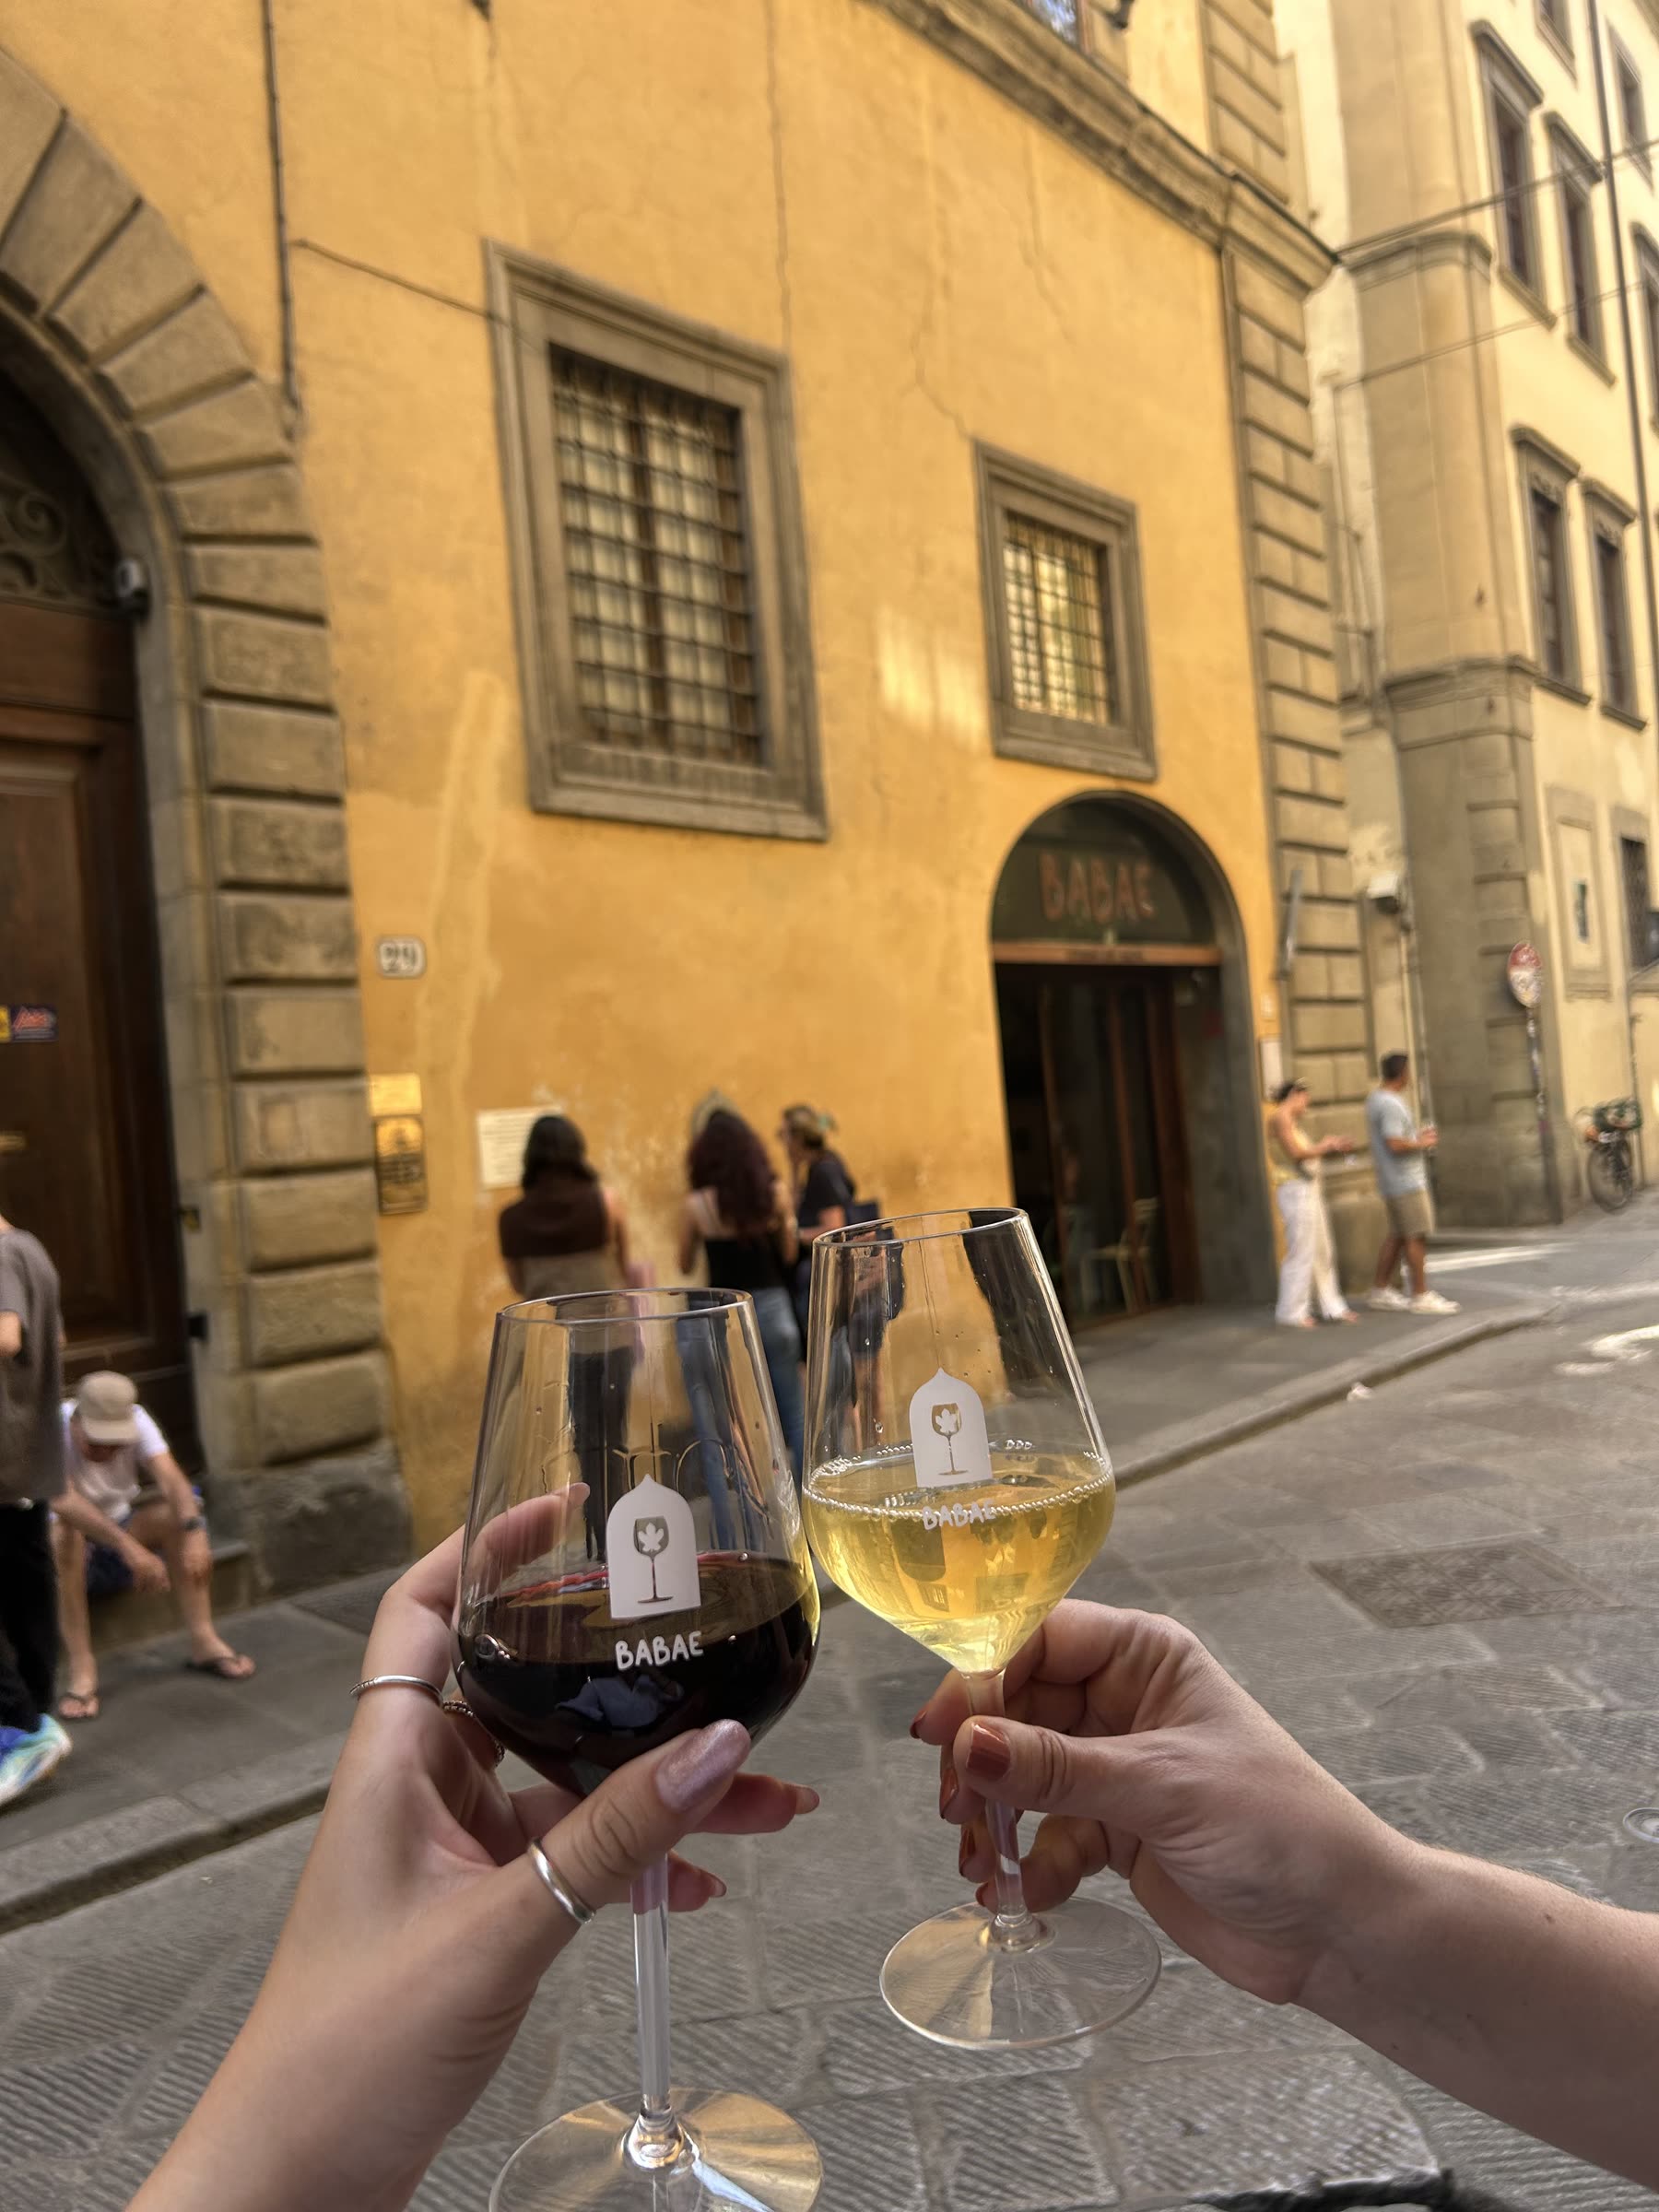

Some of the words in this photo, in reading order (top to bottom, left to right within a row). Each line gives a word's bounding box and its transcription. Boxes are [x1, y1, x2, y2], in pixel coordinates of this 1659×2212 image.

[1039, 850, 1156, 924] BABAE
[922, 1498, 996, 1530] BABAE
[615, 1630, 703, 1670] BABAE
